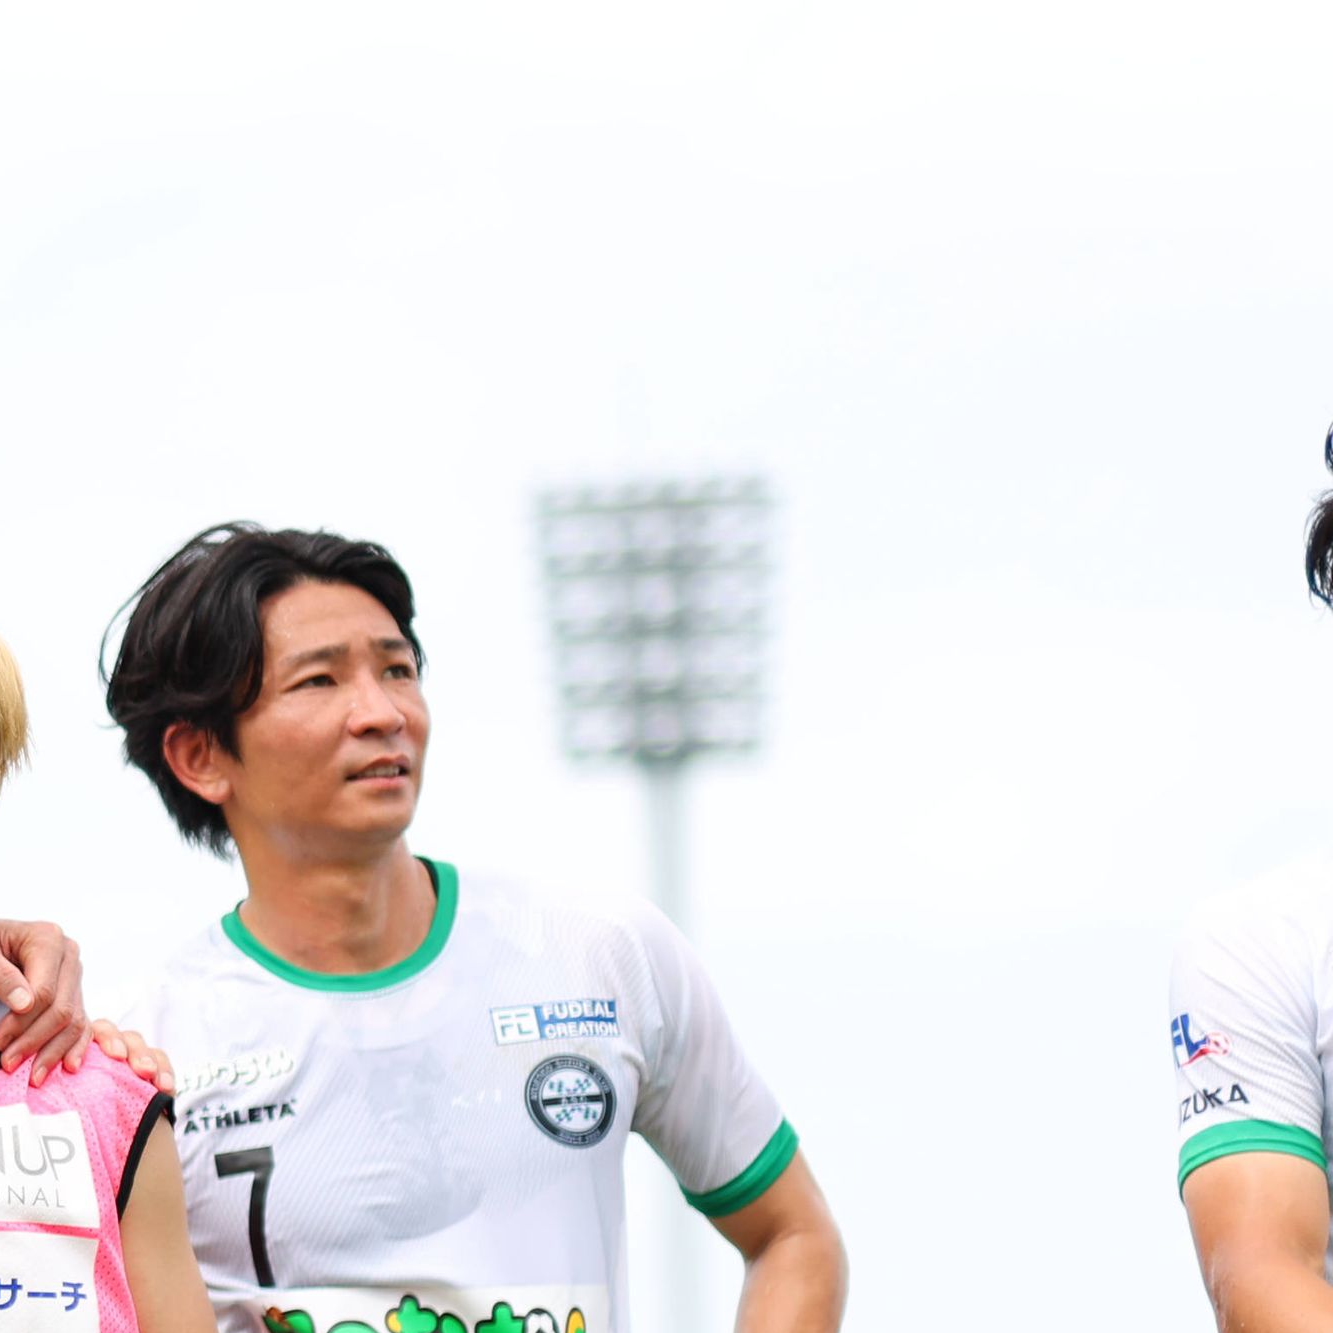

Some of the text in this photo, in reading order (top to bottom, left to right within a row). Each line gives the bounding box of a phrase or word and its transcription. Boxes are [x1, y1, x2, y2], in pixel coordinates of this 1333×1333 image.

[542, 1001, 614, 1020] FUDEAL
[545, 1021, 620, 1039] CREATION
[215, 1146, 274, 1287] 7
